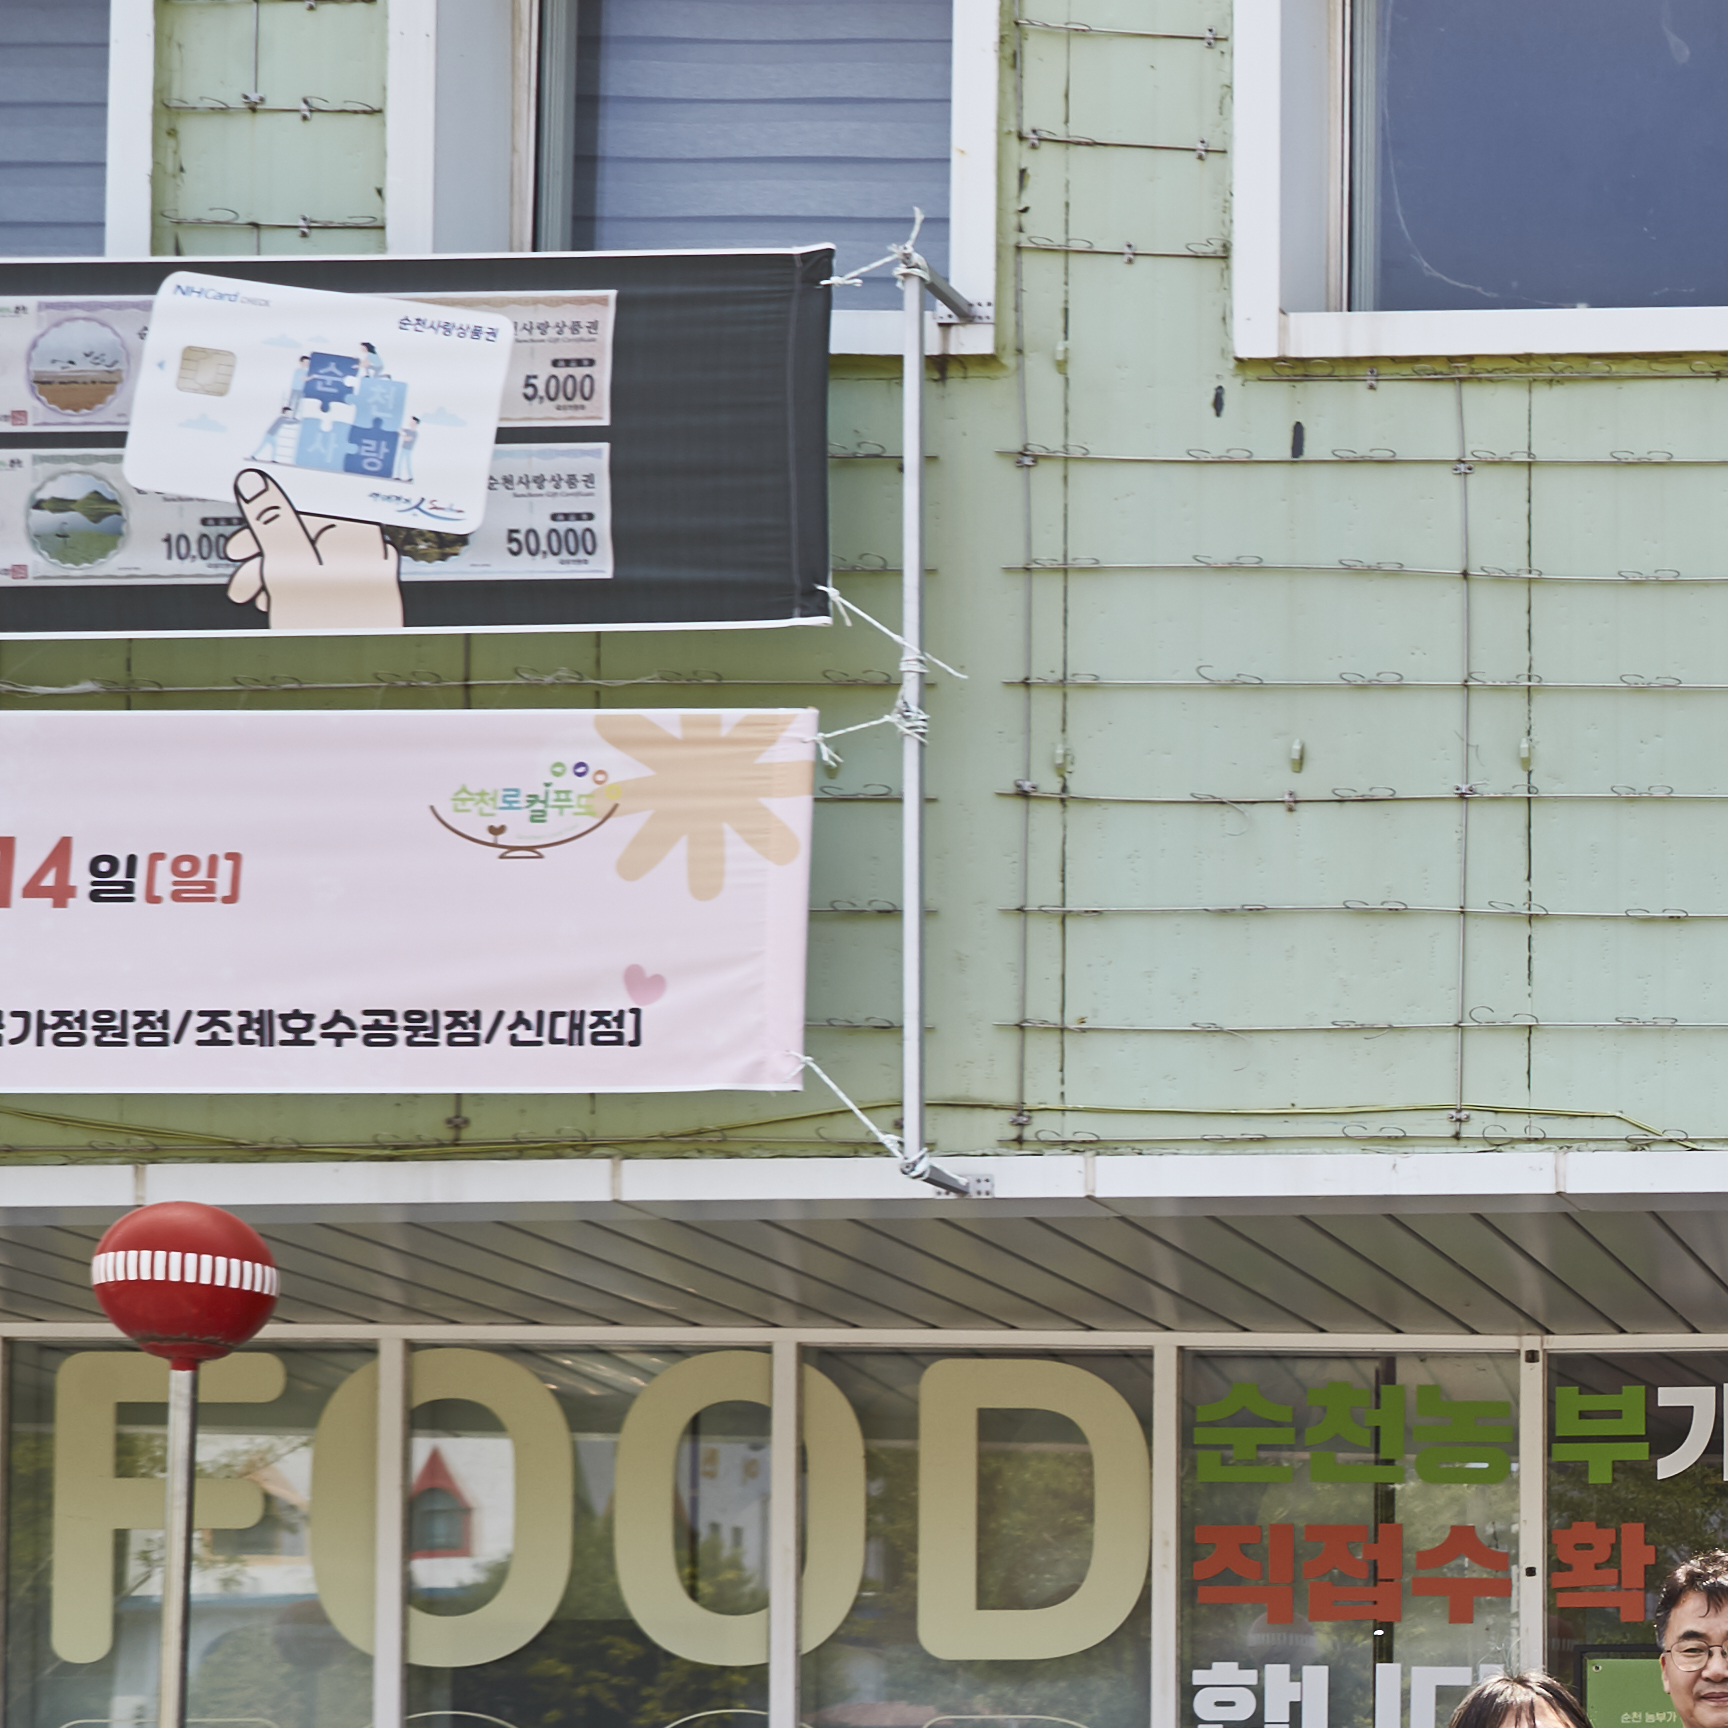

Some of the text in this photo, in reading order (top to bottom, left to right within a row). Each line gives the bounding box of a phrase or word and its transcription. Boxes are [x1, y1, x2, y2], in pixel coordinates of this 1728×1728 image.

[398, 315, 499, 343] 순천사랑상품권
[513, 319, 599, 336] 사랑상품권
[522, 374, 595, 405] 5,000
[487, 472, 596, 491] 순천사랑상품권
[161, 532, 228, 563] 10,00
[506, 527, 597, 560] 50,000
[450, 782, 598, 824] 순천로컬푸드
[0, 1007, 642, 1049] 가정원점/조례호수공원점/신대점]
[50, 1349, 1154, 1667] FOOD
